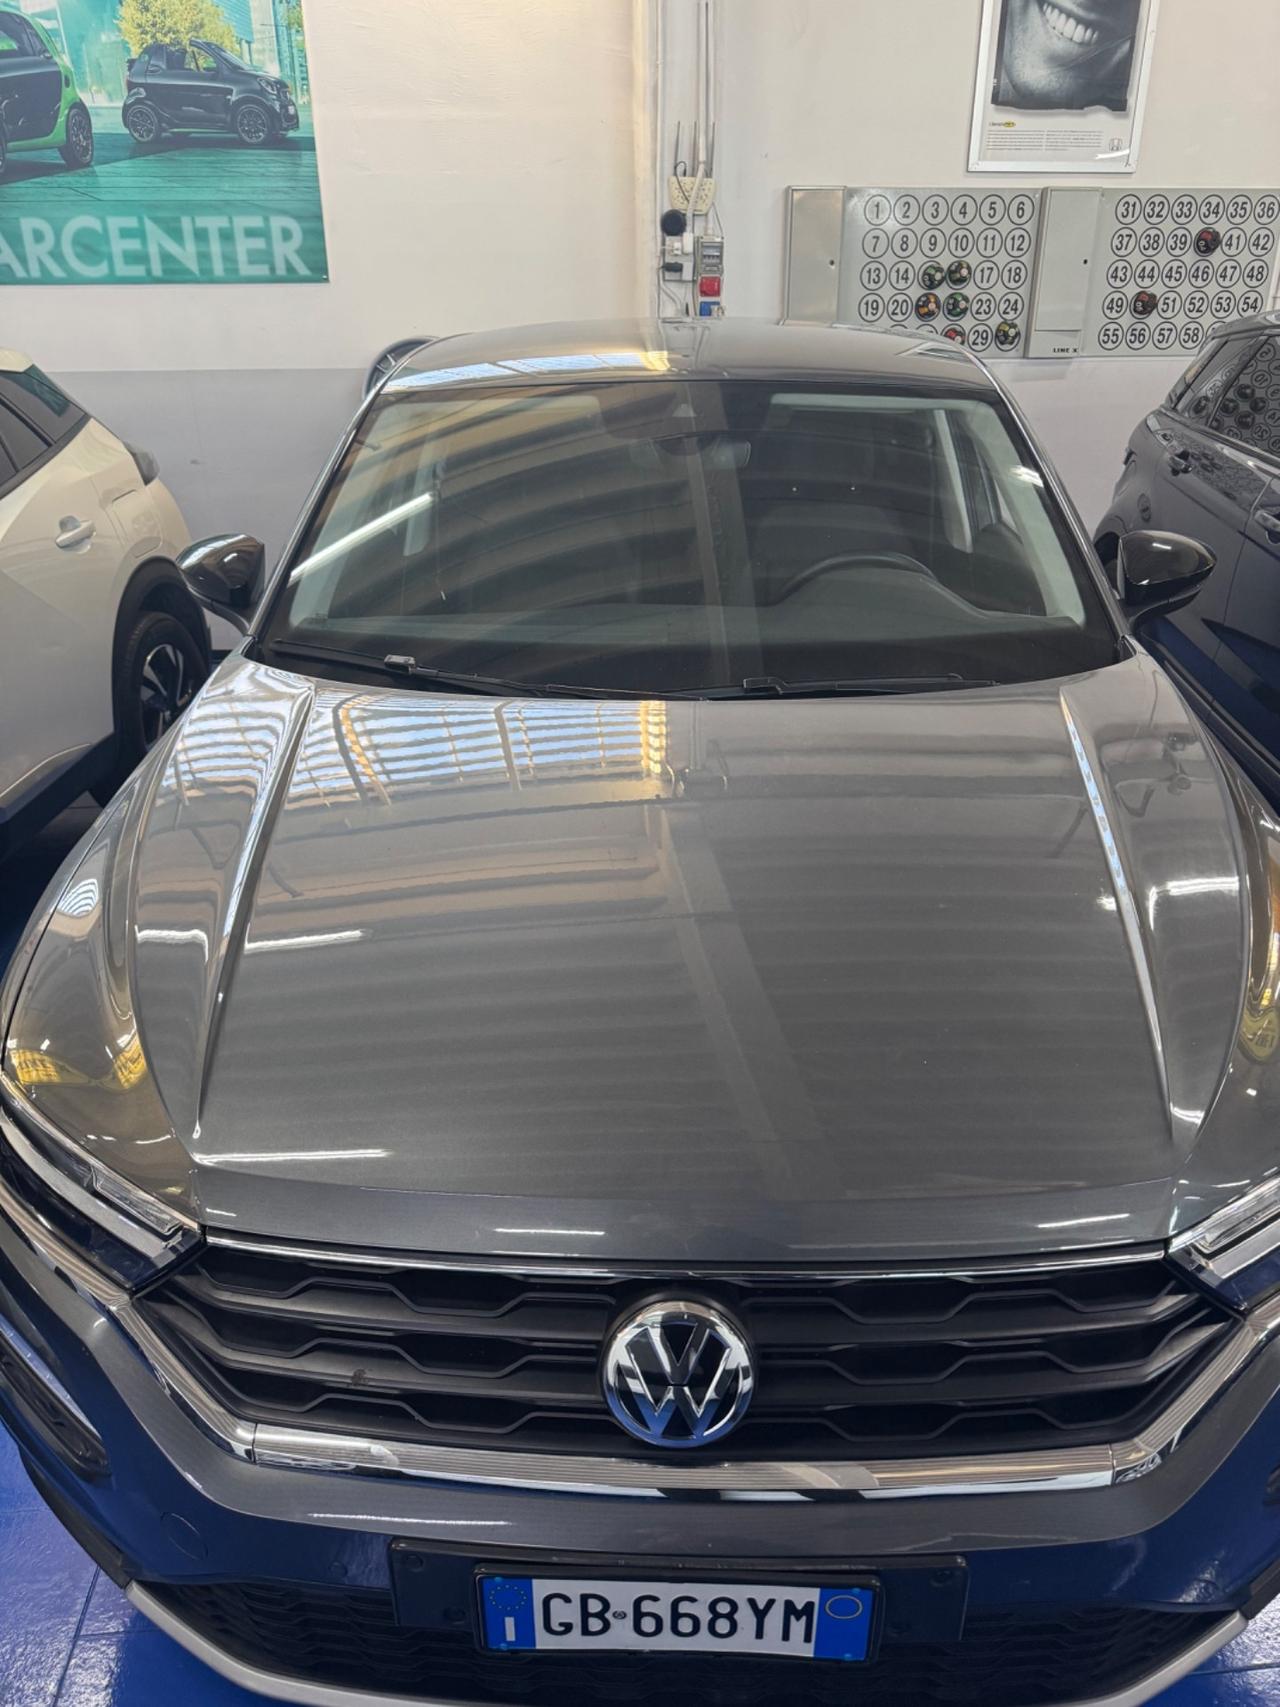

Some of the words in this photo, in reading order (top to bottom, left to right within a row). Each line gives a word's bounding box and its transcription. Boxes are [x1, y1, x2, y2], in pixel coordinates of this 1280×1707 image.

[874, 201, 880, 219] 1
[901, 200, 910, 218] 2
[930, 201, 939, 219] 3
[958, 201, 967, 218] 4
[987, 201, 996, 218] 5
[1016, 201, 1025, 219] 6
[1121, 200, 1136, 217] 31
[1146, 200, 1165, 218] 32
[1175, 200, 1192, 218] 33
[1202, 201, 1220, 218] 34
[1229, 201, 1247, 218] 35
[1257, 201, 1275, 218] 36
[872, 235, 880, 252] 7
[899, 234, 908, 252] 8
[928, 234, 937, 252] 9
[954, 234, 969, 251] 10
[983, 234, 995, 251] 11
[1010, 234, 1025, 251] 12
[1115, 233, 1132, 251] 37
[1142, 233, 1160, 250] 38
[1169, 233, 1187, 250] 39
[1224, 233, 1241, 250] 41
[1252, 233, 1270, 250] 42
[866, 267, 881, 284] 13
[895, 267, 909, 284] 14
[980, 266, 994, 283] 17
[1007, 266, 1021, 283] 18
[1110, 265, 1127, 282] 43
[1137, 265, 1155, 282] 44
[1164, 265, 1183, 282] 45
[1191, 265, 1210, 282] 46
[1219, 265, 1237, 282] 47
[1246, 265, 1264, 282] 48
[864, 299, 879, 316] 19
[890, 298, 908, 316] 20
[974, 298, 991, 315] 23
[1002, 298, 1019, 315] 24
[1106, 296, 1124, 313] 49
[1160, 296, 1177, 313] 51
[1187, 296, 1205, 313] 52
[1214, 296, 1232, 313] 53
[1241, 296, 1259, 313] 54
[971, 329, 988, 346] 29
[1101, 328, 1119, 345] 55
[1128, 327, 1146, 344] 56
[1156, 327, 1174, 344] 57
[1182, 327, 1200, 344] 58
[605, 1303, 751, 1445] VW
